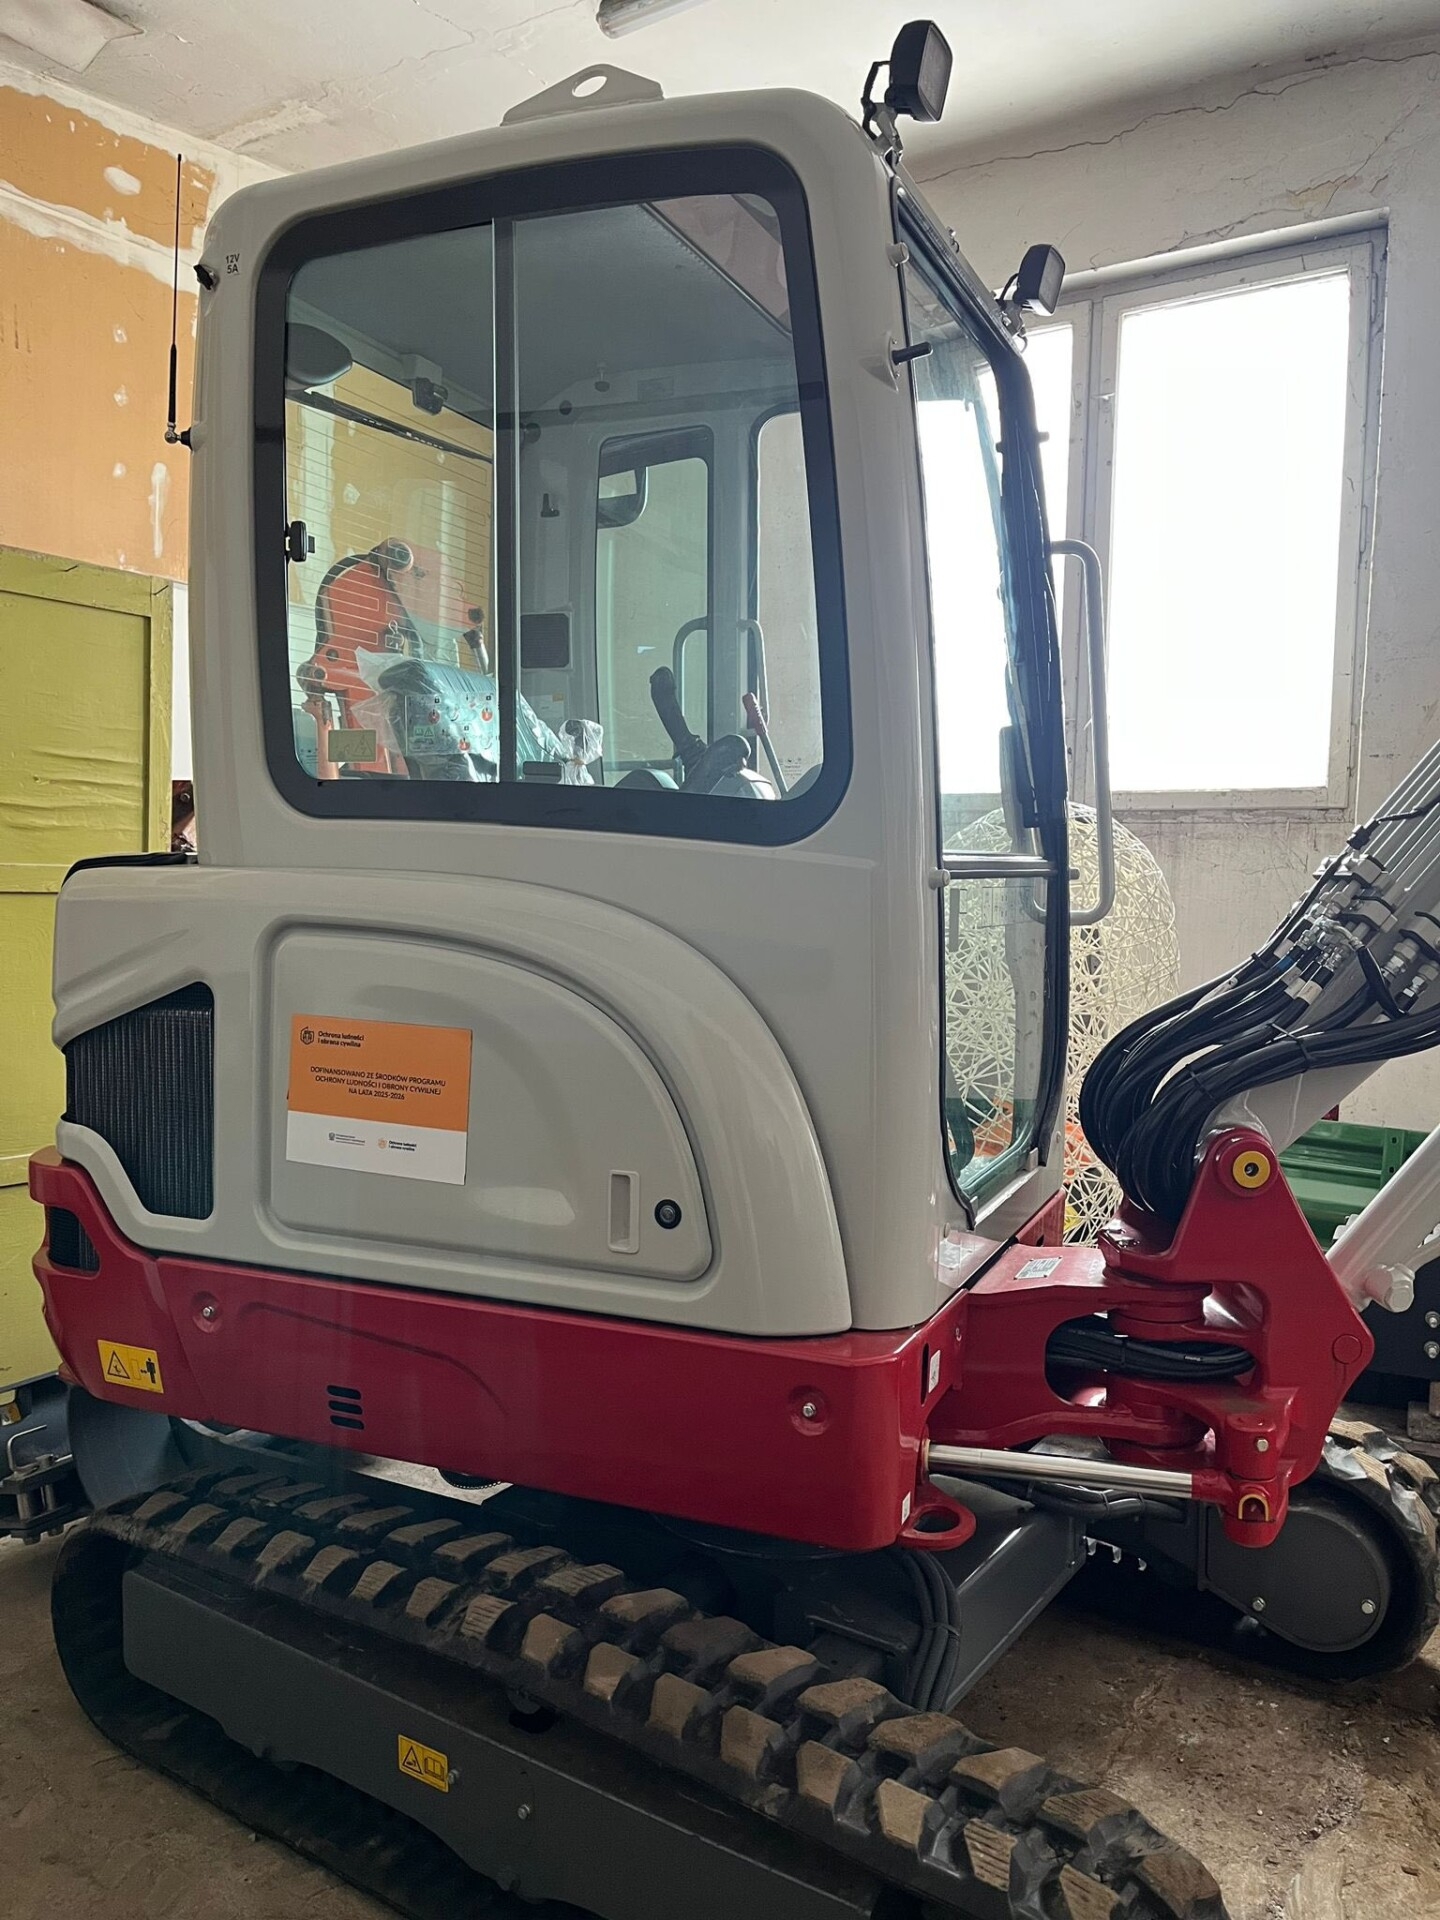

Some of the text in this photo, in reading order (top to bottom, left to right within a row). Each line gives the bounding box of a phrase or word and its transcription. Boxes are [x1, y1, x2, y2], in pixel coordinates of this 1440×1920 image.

[225, 253, 240, 264] 12V
[227, 264, 239, 274] 5A
[342, 1033, 364, 1041] ludności
[311, 1066, 366, 1078] DOFINANSOWANO
[375, 1072, 408, 1082] ŚRODKÓW
[409, 1077, 446, 1087] PROGRAMU
[315, 1075, 346, 1084] OCHRONY
[346, 1079, 377, 1088] LUDNOŚCI
[382, 1083, 409, 1092] OBRONY
[410, 1086, 441, 1095] CYWILNEJ
[374, 1091, 405, 1100] 2025-2026
